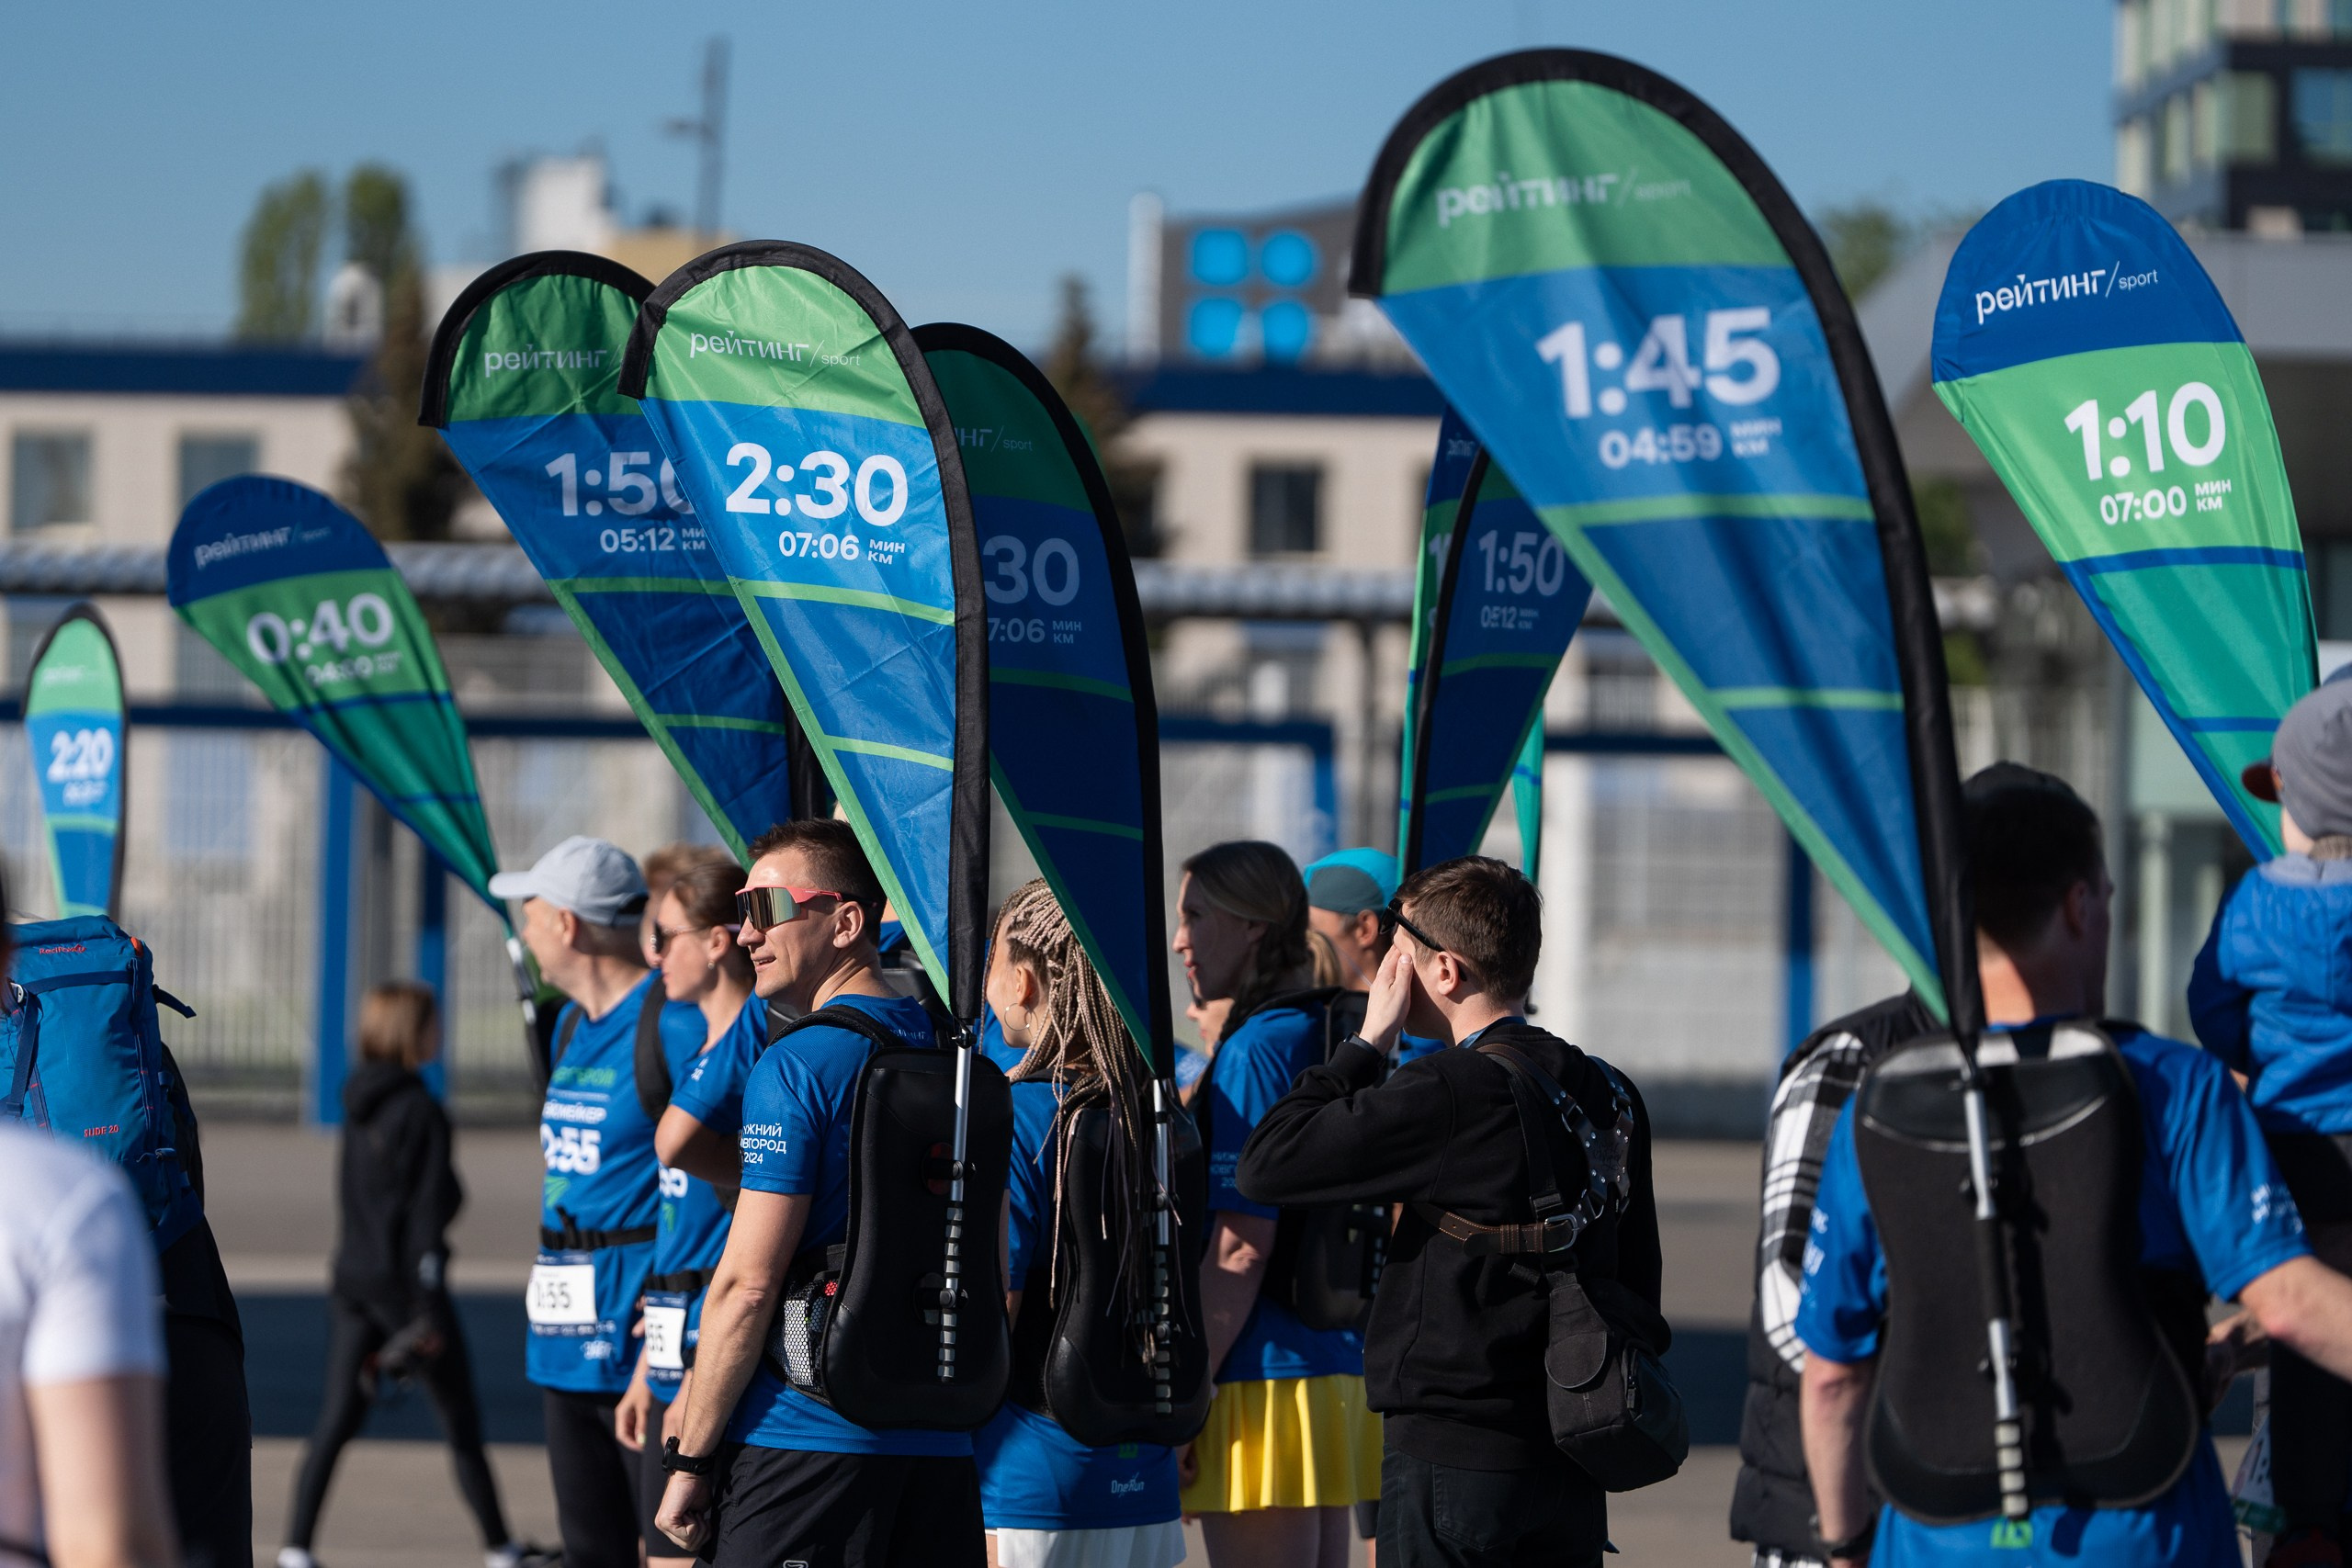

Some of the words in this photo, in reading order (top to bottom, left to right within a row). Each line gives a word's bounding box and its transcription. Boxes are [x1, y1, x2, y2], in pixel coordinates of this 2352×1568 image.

[1975, 269, 2107, 325] рейтинг
[2118, 269, 2159, 291] sport
[483, 344, 608, 378] рейтинг
[689, 330, 809, 362] рейтинг
[820, 353, 861, 367] sport
[1535, 306, 1781, 419] 1:45
[1002, 438, 1033, 451] sport
[1598, 423, 1724, 469] 04:59
[2064, 381, 2226, 481] 1:10
[725, 442, 909, 526] 2:30
[2099, 485, 2188, 525] 07:00
[599, 527, 675, 553] 05:12
[778, 530, 860, 561] 07:06
[1477, 529, 1566, 596] 1:50
[982, 534, 1080, 607] 30
[246, 592, 394, 666] 0:40
[987, 617, 1046, 643] 7:06
